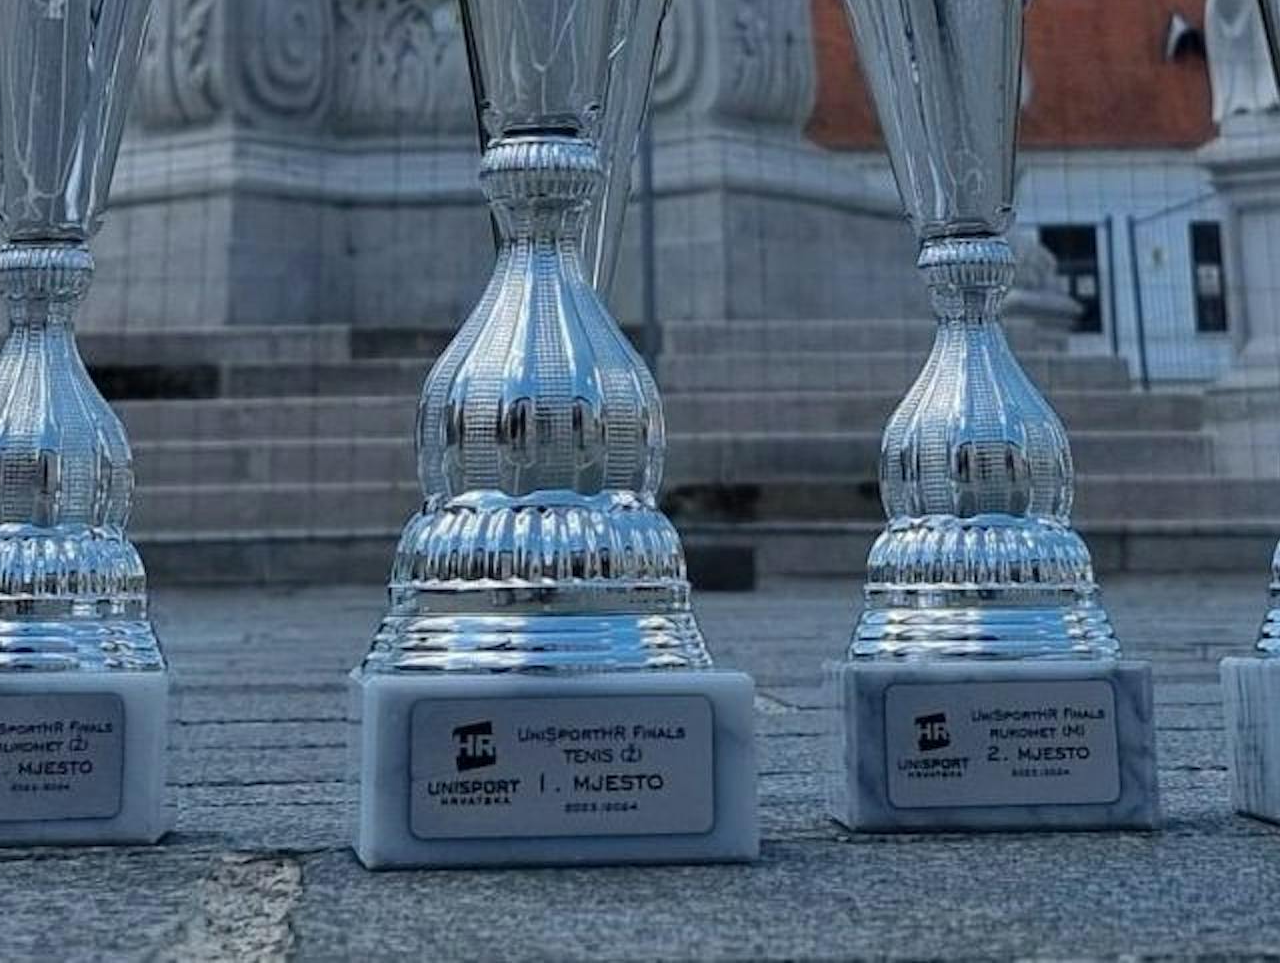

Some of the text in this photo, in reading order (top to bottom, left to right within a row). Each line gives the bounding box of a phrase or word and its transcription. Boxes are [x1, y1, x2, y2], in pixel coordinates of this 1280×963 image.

[990, 727, 1057, 738] RUKOMET
[563, 748, 613, 763] TENIS
[987, 746, 1089, 761] 2. MJESTO
[18, 760, 92, 776] MJESTO
[897, 757, 968, 770] UNISPORT
[427, 780, 520, 795] UNISPORT
[574, 774, 664, 791] MJESTO
